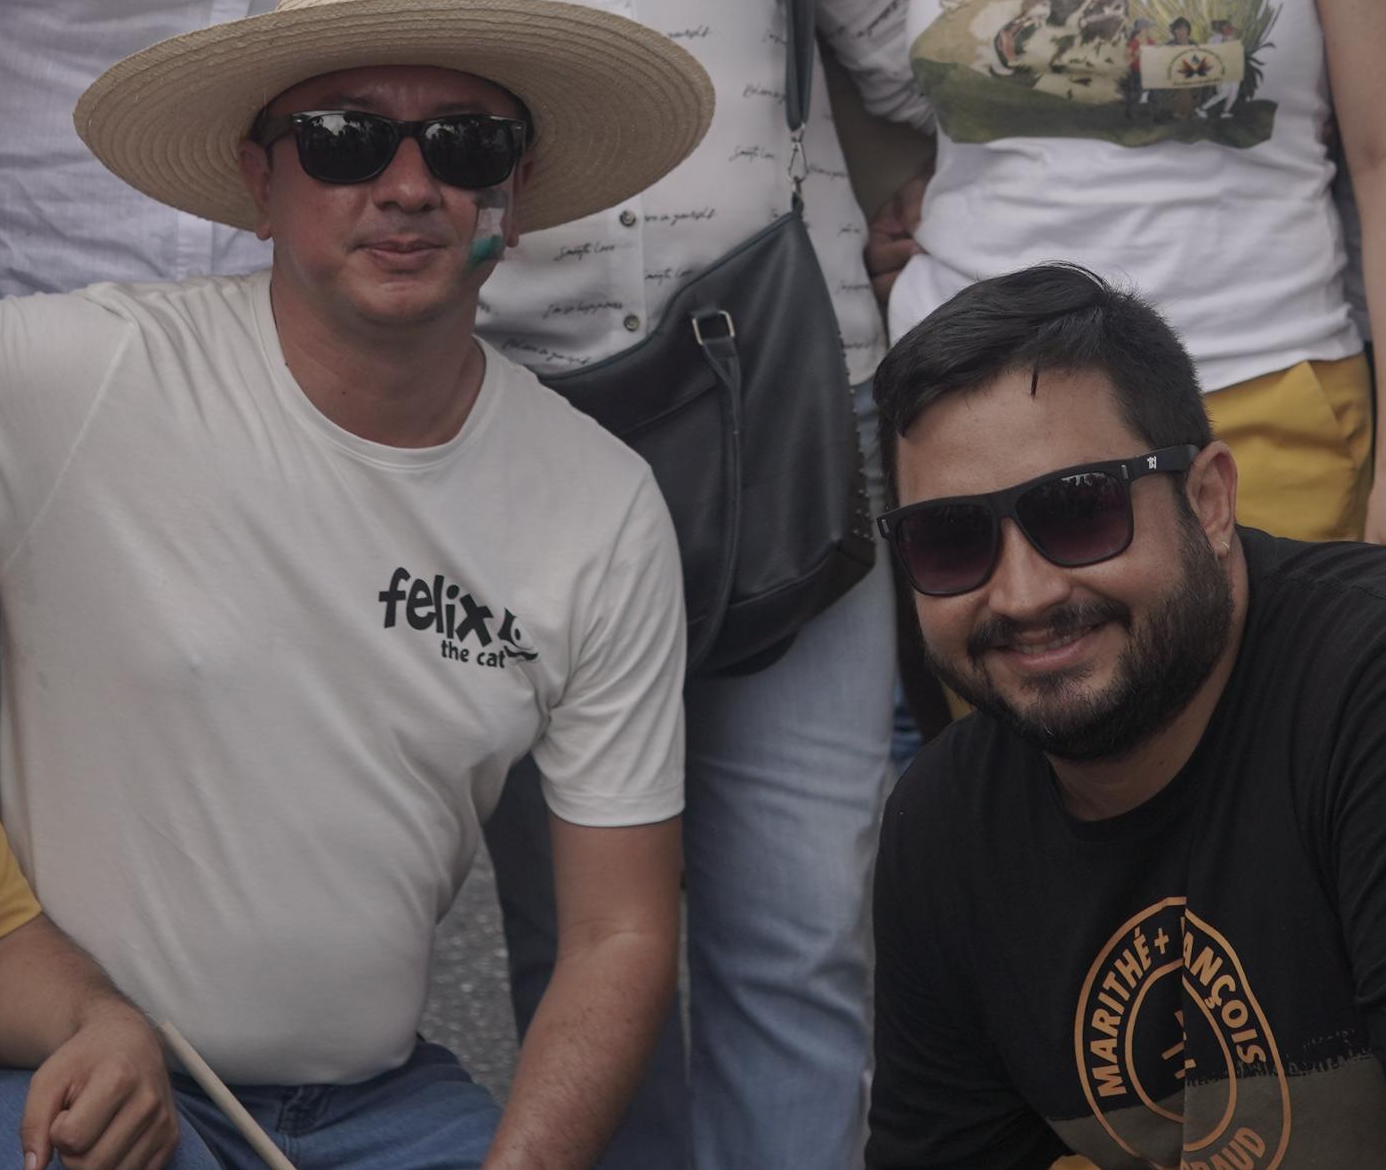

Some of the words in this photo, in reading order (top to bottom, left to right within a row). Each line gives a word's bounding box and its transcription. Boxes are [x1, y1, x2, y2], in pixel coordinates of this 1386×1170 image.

[378, 566, 494, 648] felix
[441, 639, 470, 663] the
[476, 648, 507, 669] cat
